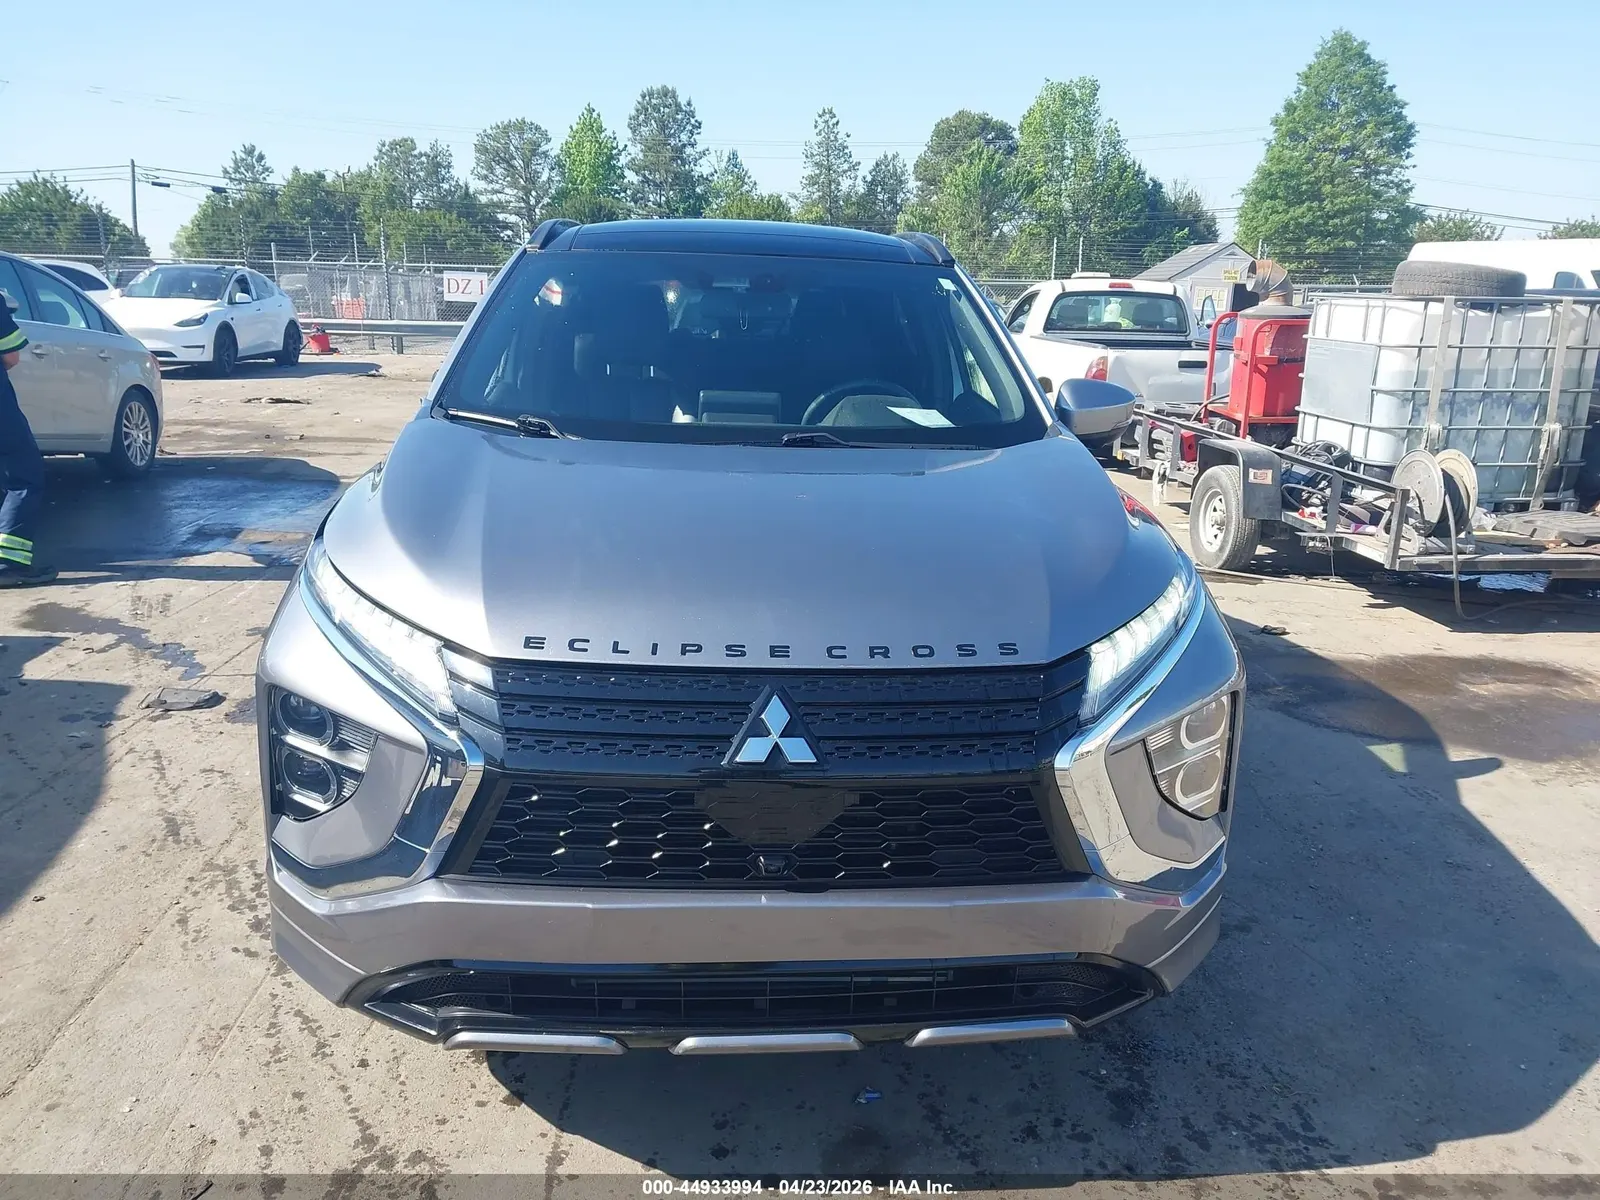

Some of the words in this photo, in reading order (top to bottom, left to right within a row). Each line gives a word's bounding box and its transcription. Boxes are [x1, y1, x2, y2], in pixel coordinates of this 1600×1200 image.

[446, 277, 472, 294] DZ
[479, 279, 485, 295] 1
[523, 636, 791, 659] ECLIPSE
[826, 642, 1019, 660] CROSS
